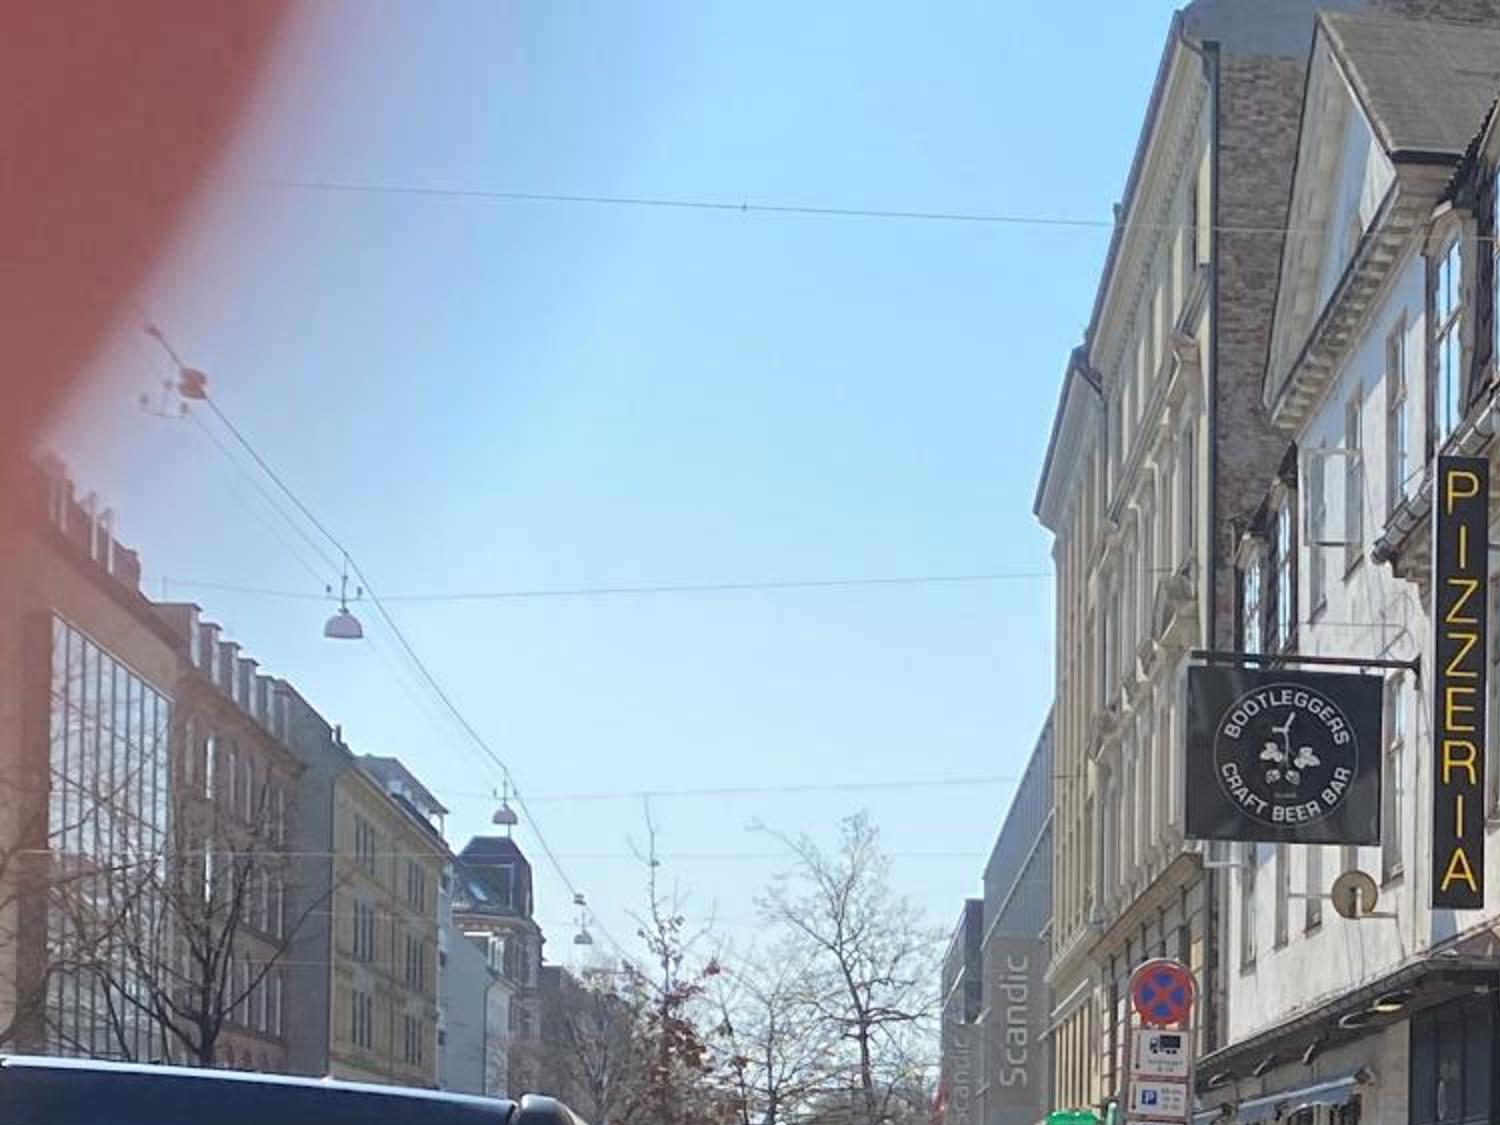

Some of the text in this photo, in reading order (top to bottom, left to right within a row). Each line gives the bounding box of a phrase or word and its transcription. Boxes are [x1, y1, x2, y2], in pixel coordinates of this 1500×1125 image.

[1224, 689, 1350, 745] BOOTLEGGERS
[1440, 470, 1480, 892] PIZZERIA
[1221, 762, 1352, 822] CRAFT BEER BAR
[1001, 954, 1028, 1088] Scandic
